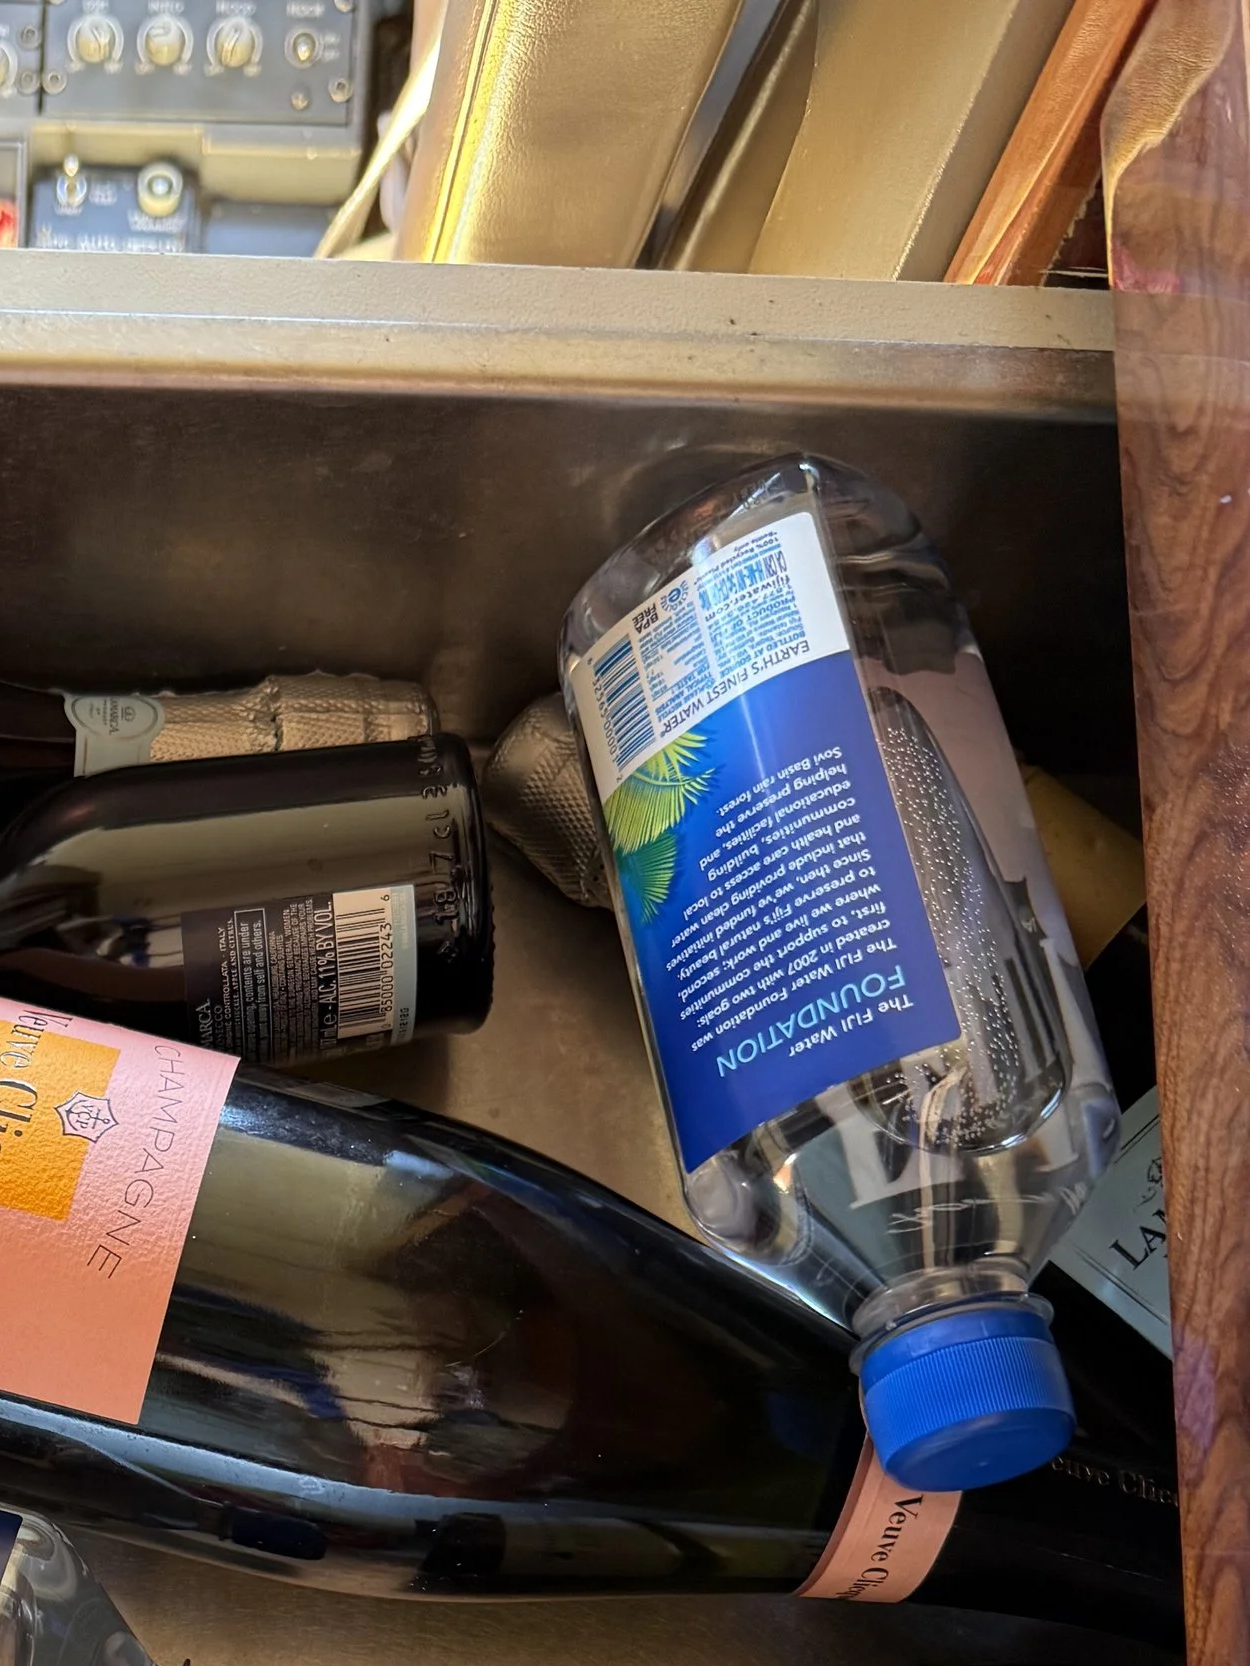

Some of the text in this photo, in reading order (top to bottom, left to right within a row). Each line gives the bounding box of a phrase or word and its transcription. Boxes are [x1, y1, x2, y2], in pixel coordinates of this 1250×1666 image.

[630, 602, 657, 625] FREE
[633, 611, 660, 634] BPA
[749, 639, 810, 675] EARTH'S
[703, 668, 749, 704] FINEST
[317, 899, 331, 928] VOL.
[317, 928, 334, 949] BY
[380, 921, 393, 969] 02243
[691, 919, 890, 1030] created in 2007 with two goals:
[691, 937, 897, 1051] The FIJI Water Foundation was
[716, 965, 905, 1076] FOUNDATION
[789, 994, 913, 1056] The FIJI Water
[83, 1037, 193, 1286] CHAMPAGNE
[871, 1493, 924, 1563] Veuve
